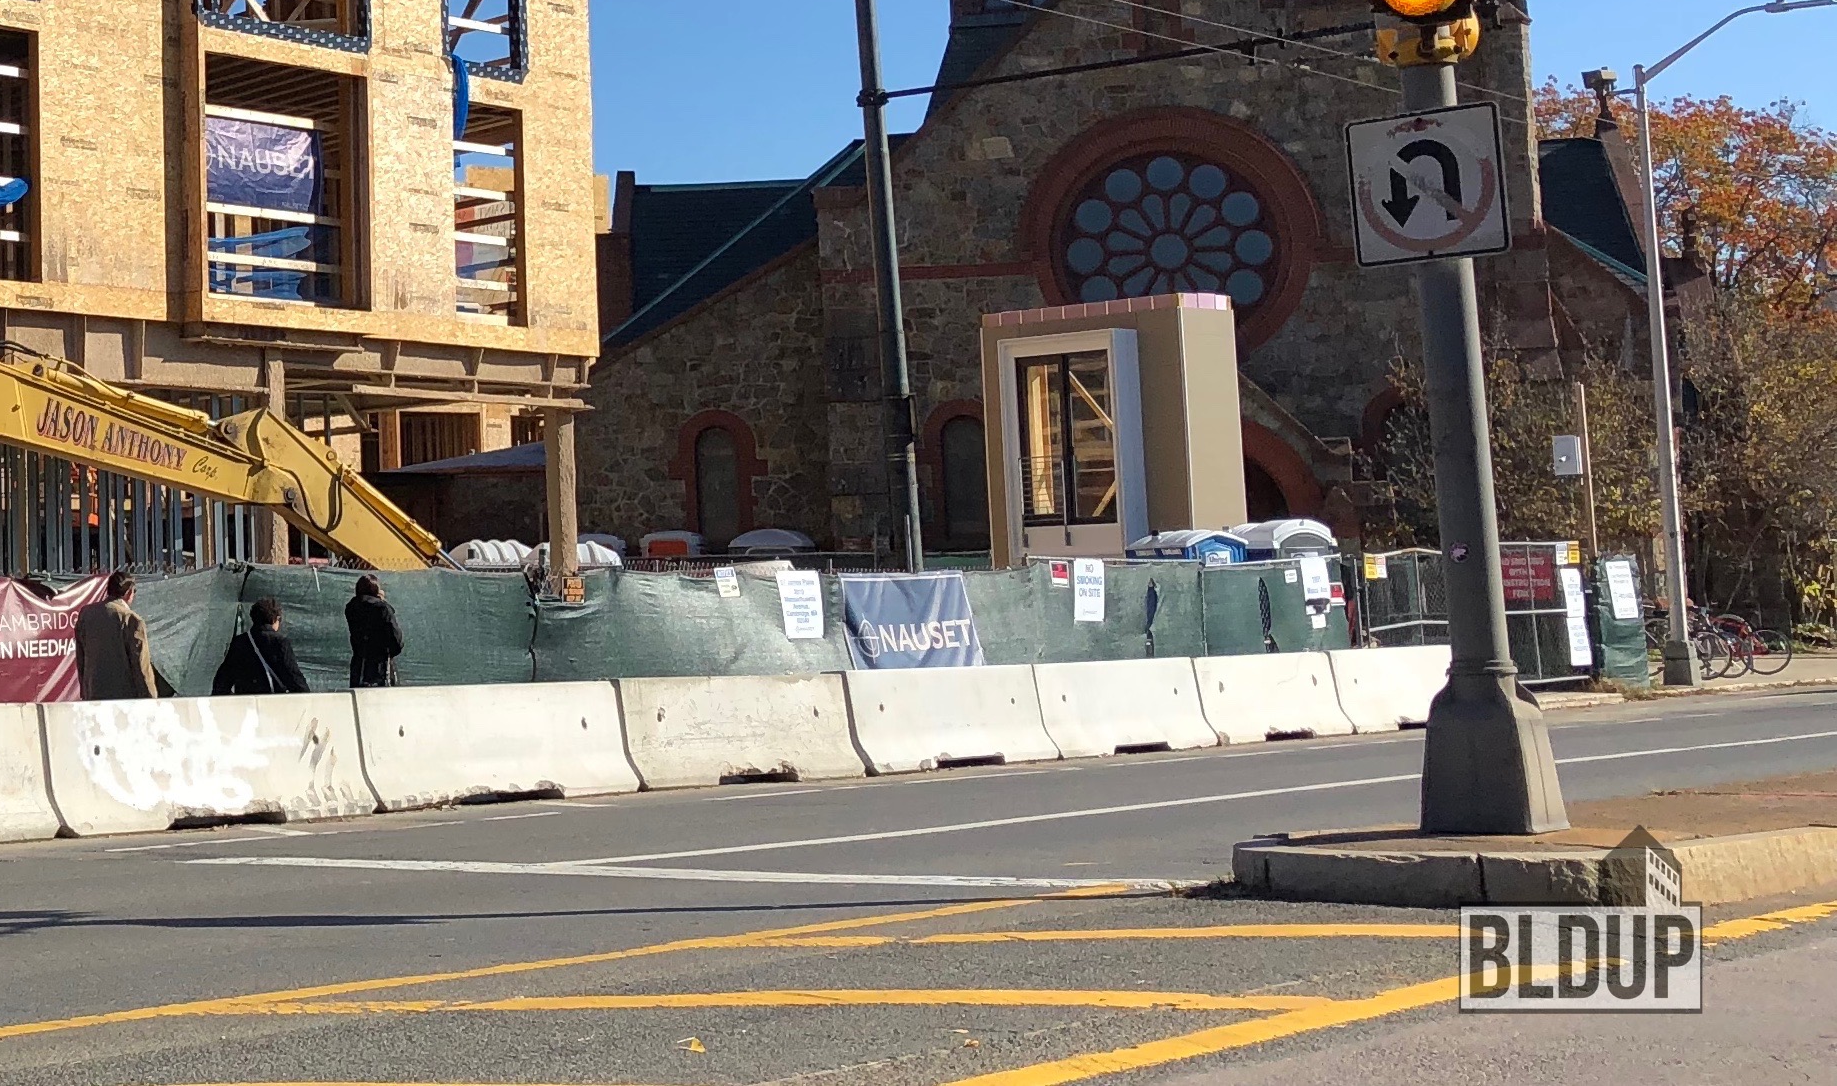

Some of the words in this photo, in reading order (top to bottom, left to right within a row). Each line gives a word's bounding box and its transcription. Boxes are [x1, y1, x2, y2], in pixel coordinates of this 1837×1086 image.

[37, 397, 100, 450] JASON
[101, 422, 187, 471] ANTHONY
[1077, 576, 1102, 585] SMOKING
[17, 638, 76, 658] NEEDHA
[878, 619, 971, 652] NAUSET
